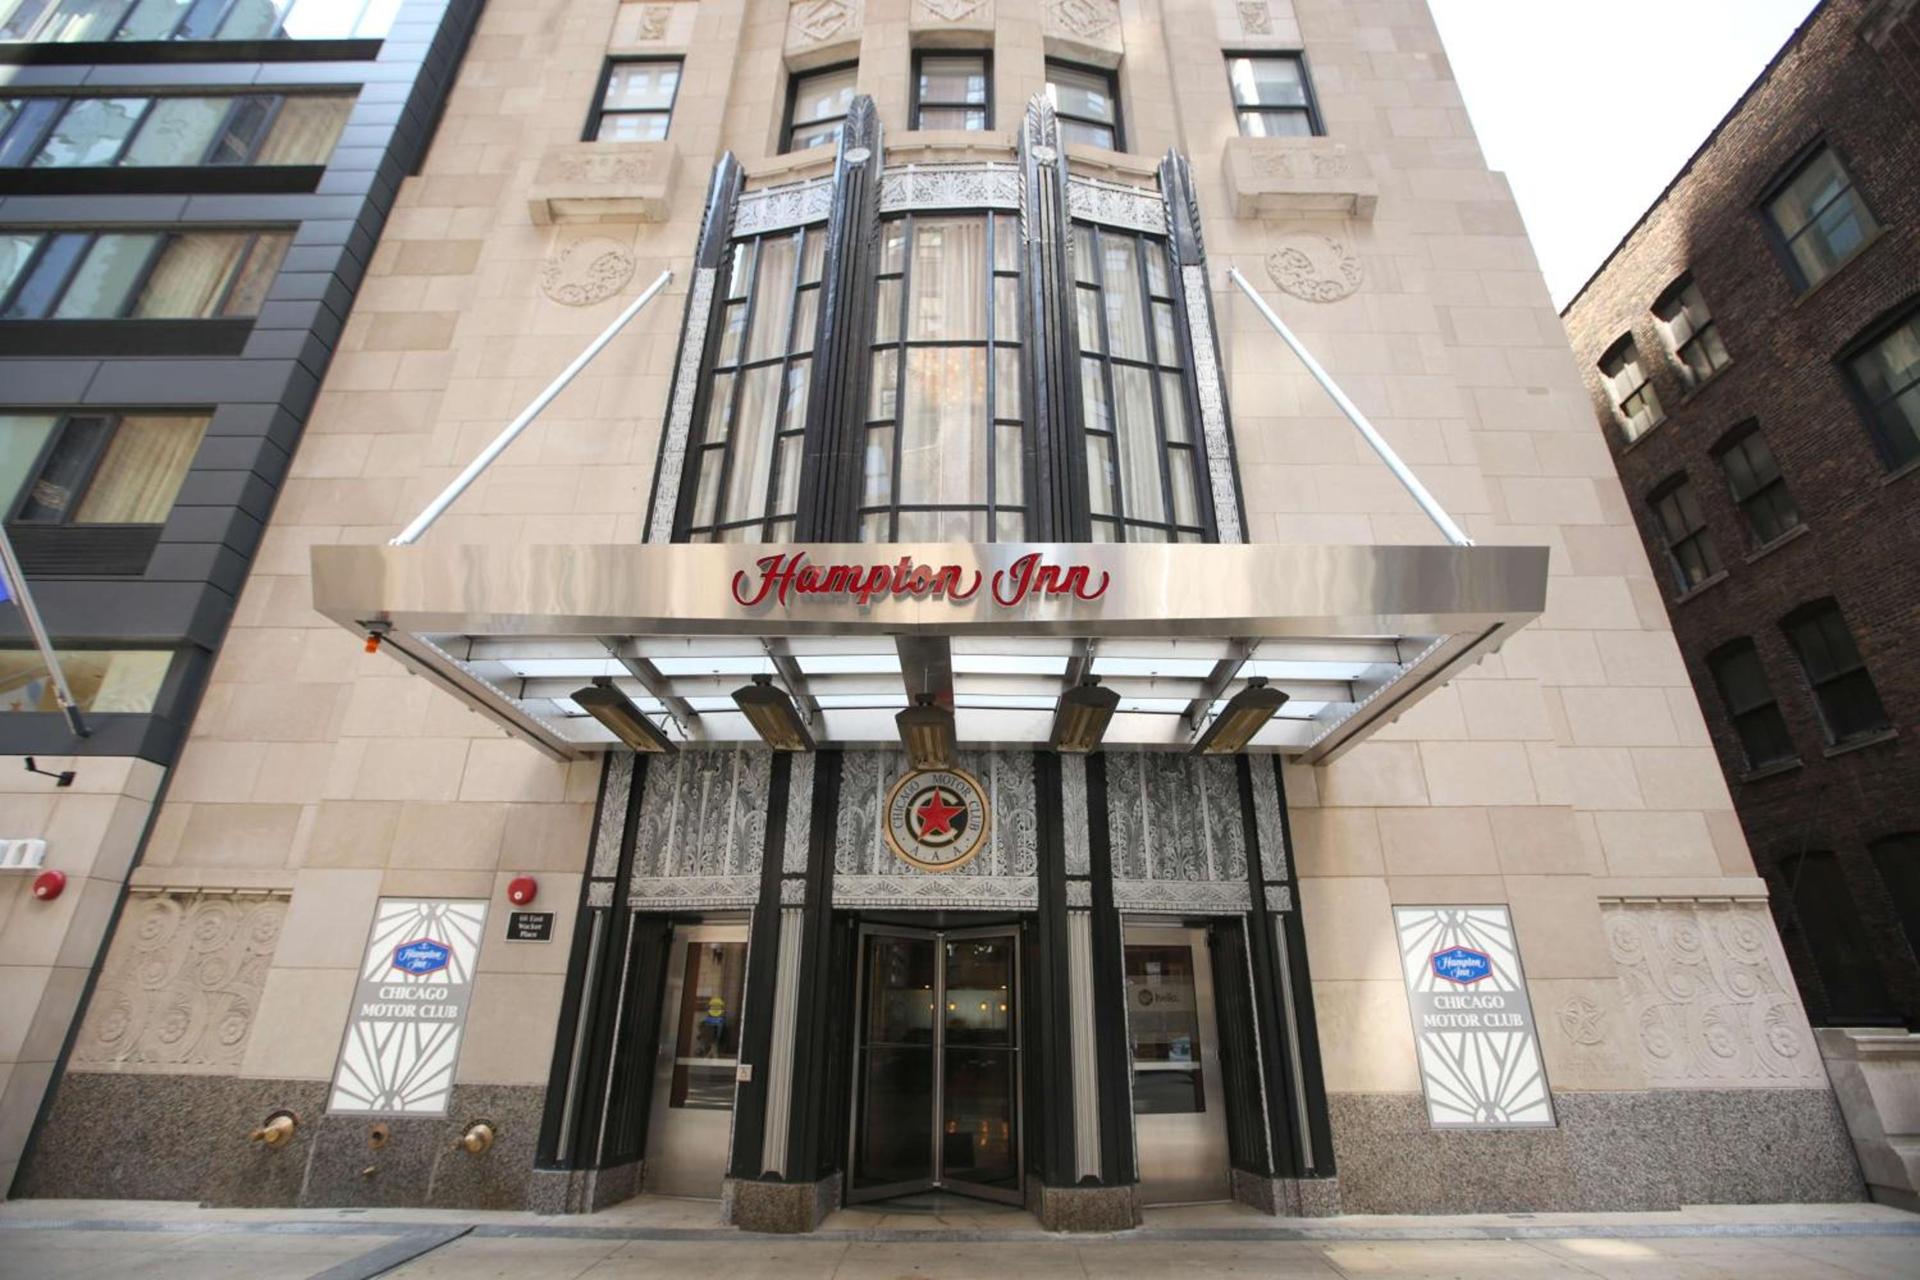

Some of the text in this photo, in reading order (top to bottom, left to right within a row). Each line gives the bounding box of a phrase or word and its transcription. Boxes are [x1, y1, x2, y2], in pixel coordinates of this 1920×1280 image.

[732, 551, 1110, 606] Hampton Inn
[931, 774, 971, 797] MOTOR
[968, 800, 981, 831] CLUB
[1437, 956, 1485, 969] Hampton
[379, 986, 448, 1000] CHICAGO
[1434, 995, 1505, 1009] CHICAGO
[360, 1003, 458, 1018] MOTOR CLUB
[1423, 1013, 1524, 1027] MOTOR CLUB
